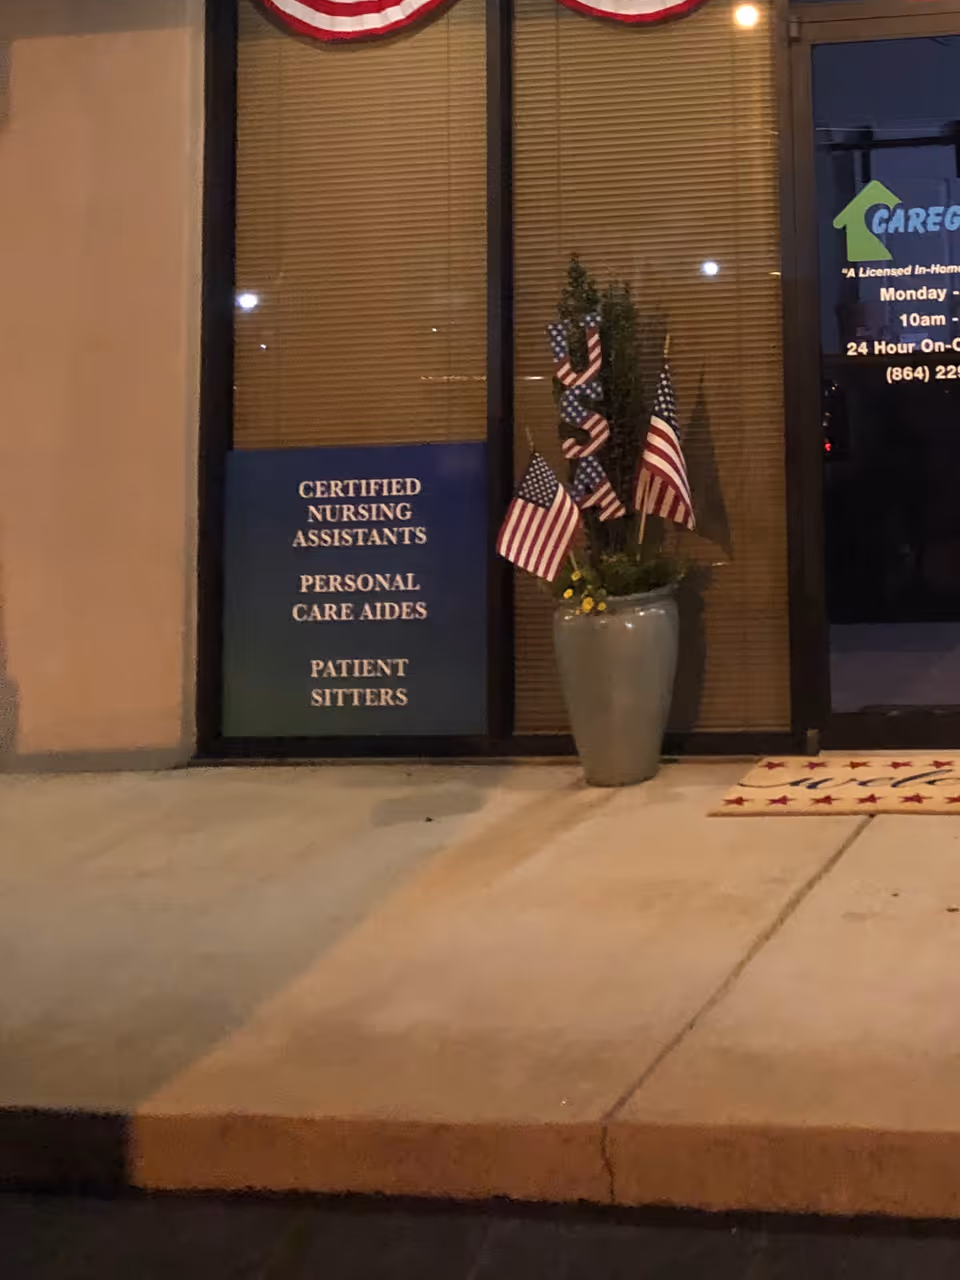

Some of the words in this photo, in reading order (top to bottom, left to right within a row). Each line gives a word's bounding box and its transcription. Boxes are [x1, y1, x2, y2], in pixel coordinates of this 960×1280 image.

[858, 265, 912, 279] Licensed
[879, 287, 947, 303] Monday
[900, 312, 946, 327] 10am
[846, 341, 868, 356] 24
[874, 340, 915, 354] Hour
[886, 366, 930, 384] (864)
[298, 478, 421, 498] CERTIFIED
[307, 503, 412, 522] NURSING
[292, 527, 427, 548] ASSISTANTS
[300, 573, 421, 592] PERSONAL
[292, 604, 353, 621] CARE
[359, 602, 428, 620] AIDES
[310, 659, 409, 677] PATIENT
[311, 688, 408, 707] SITTERS
